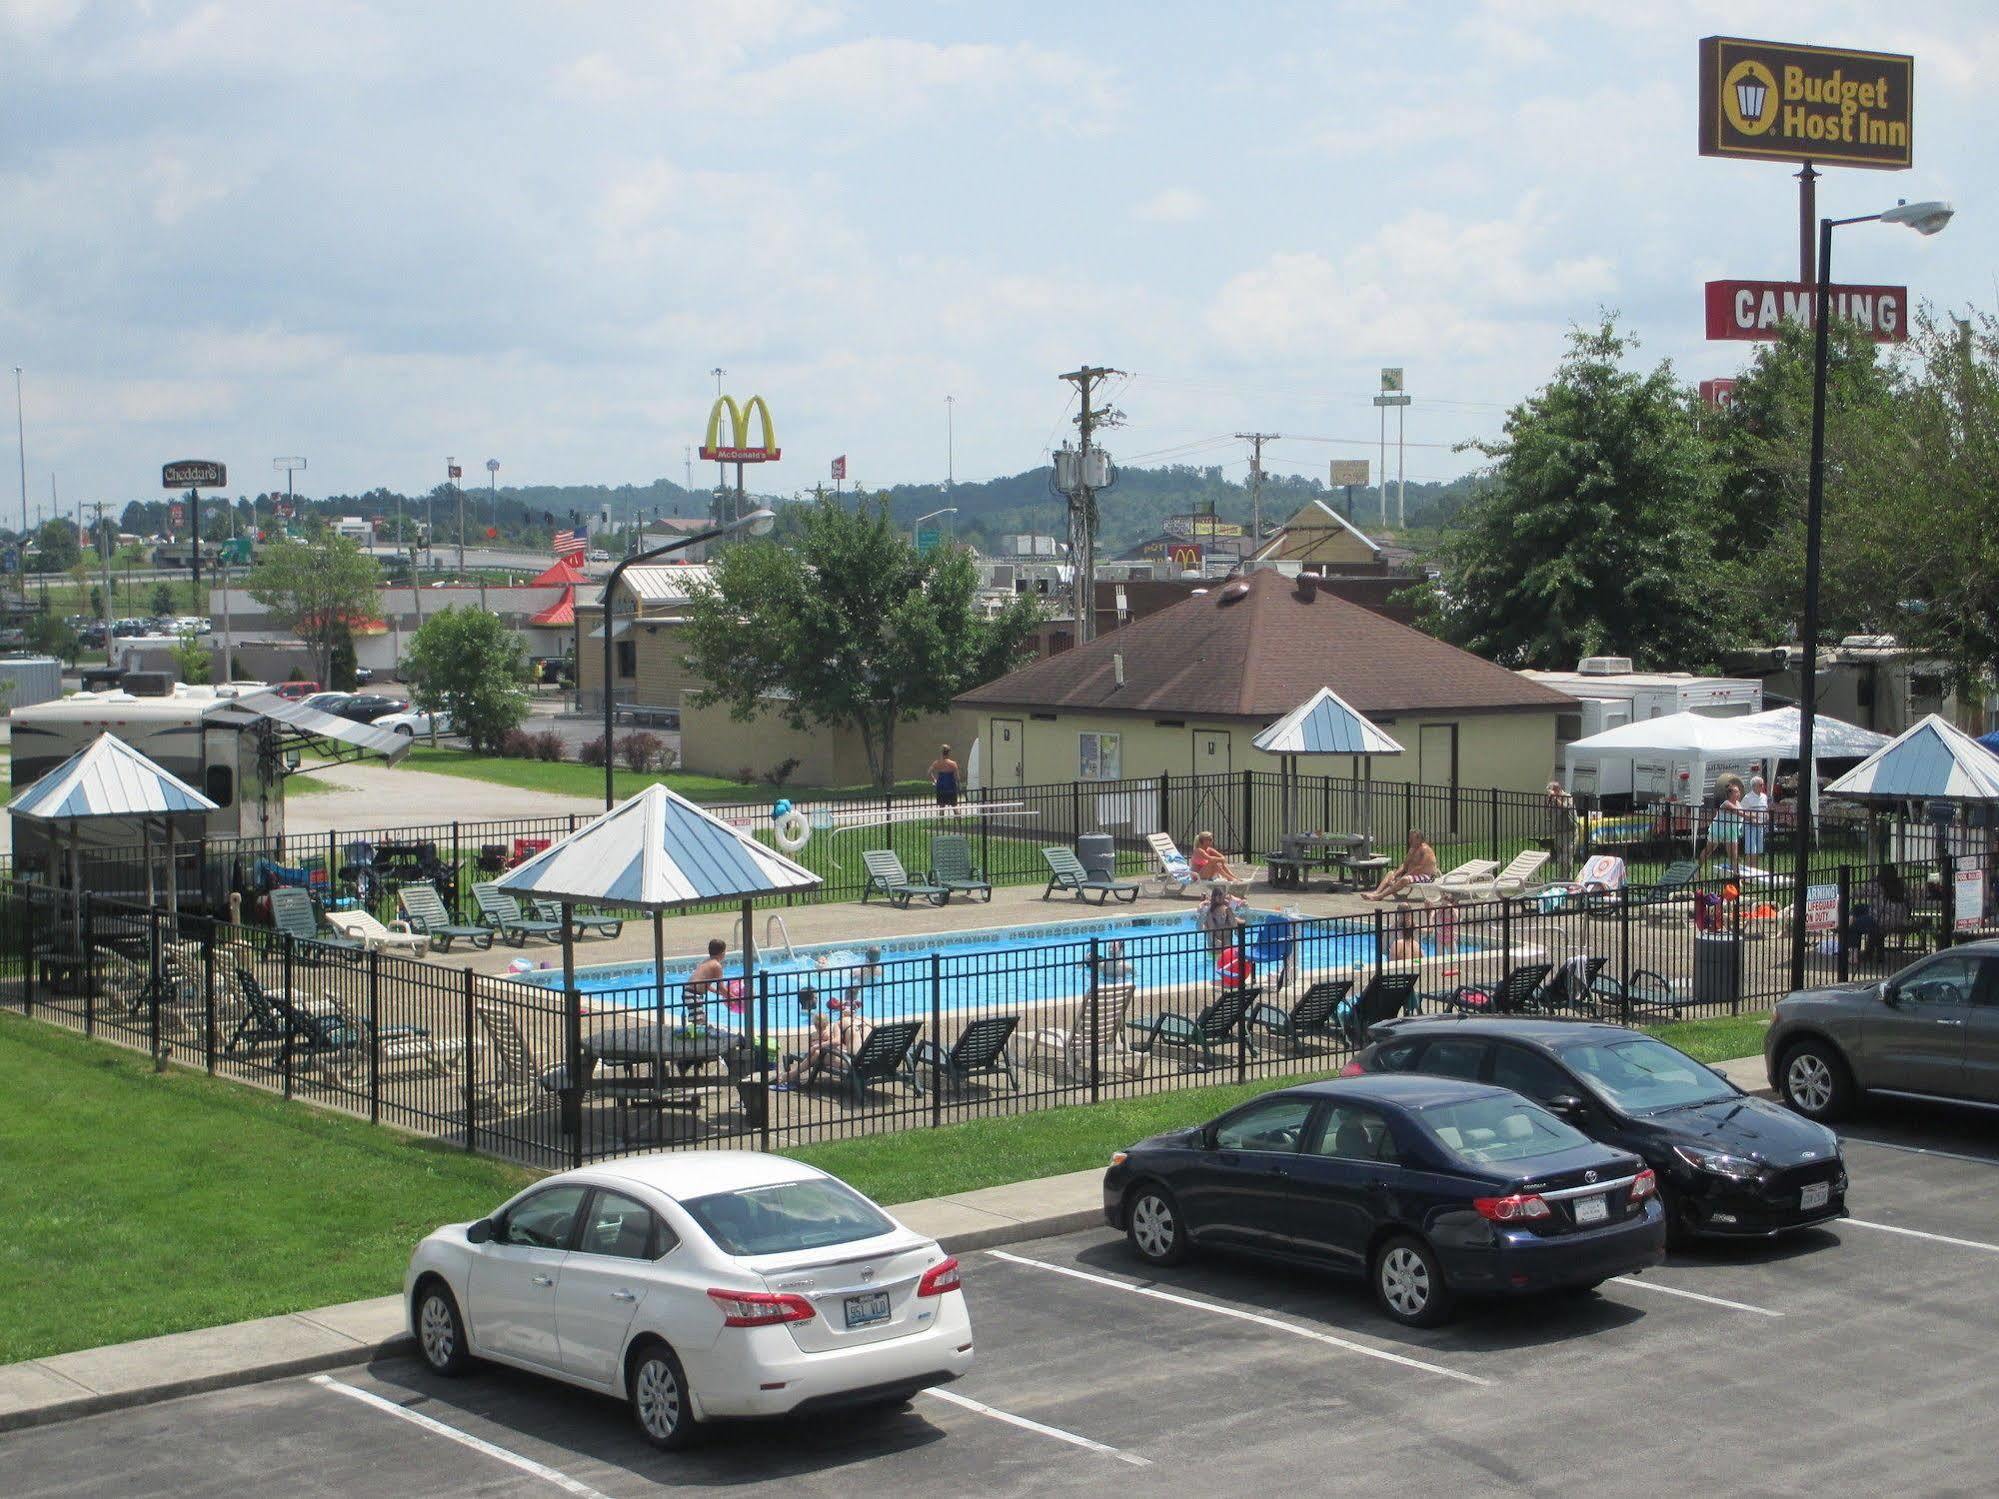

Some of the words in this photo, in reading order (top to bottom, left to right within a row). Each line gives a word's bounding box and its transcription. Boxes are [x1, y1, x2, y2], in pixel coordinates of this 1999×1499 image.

[1783, 64, 1889, 115] Budget
[1782, 106, 1854, 143] Host
[1859, 112, 1906, 146] Inn
[1734, 288, 1897, 334] CAMING
[717, 451, 767, 460] McDonald's
[165, 465, 217, 482] Cheddar's
[1807, 885, 1839, 901] ARNING!
[1815, 911, 1830, 922] DUTY
